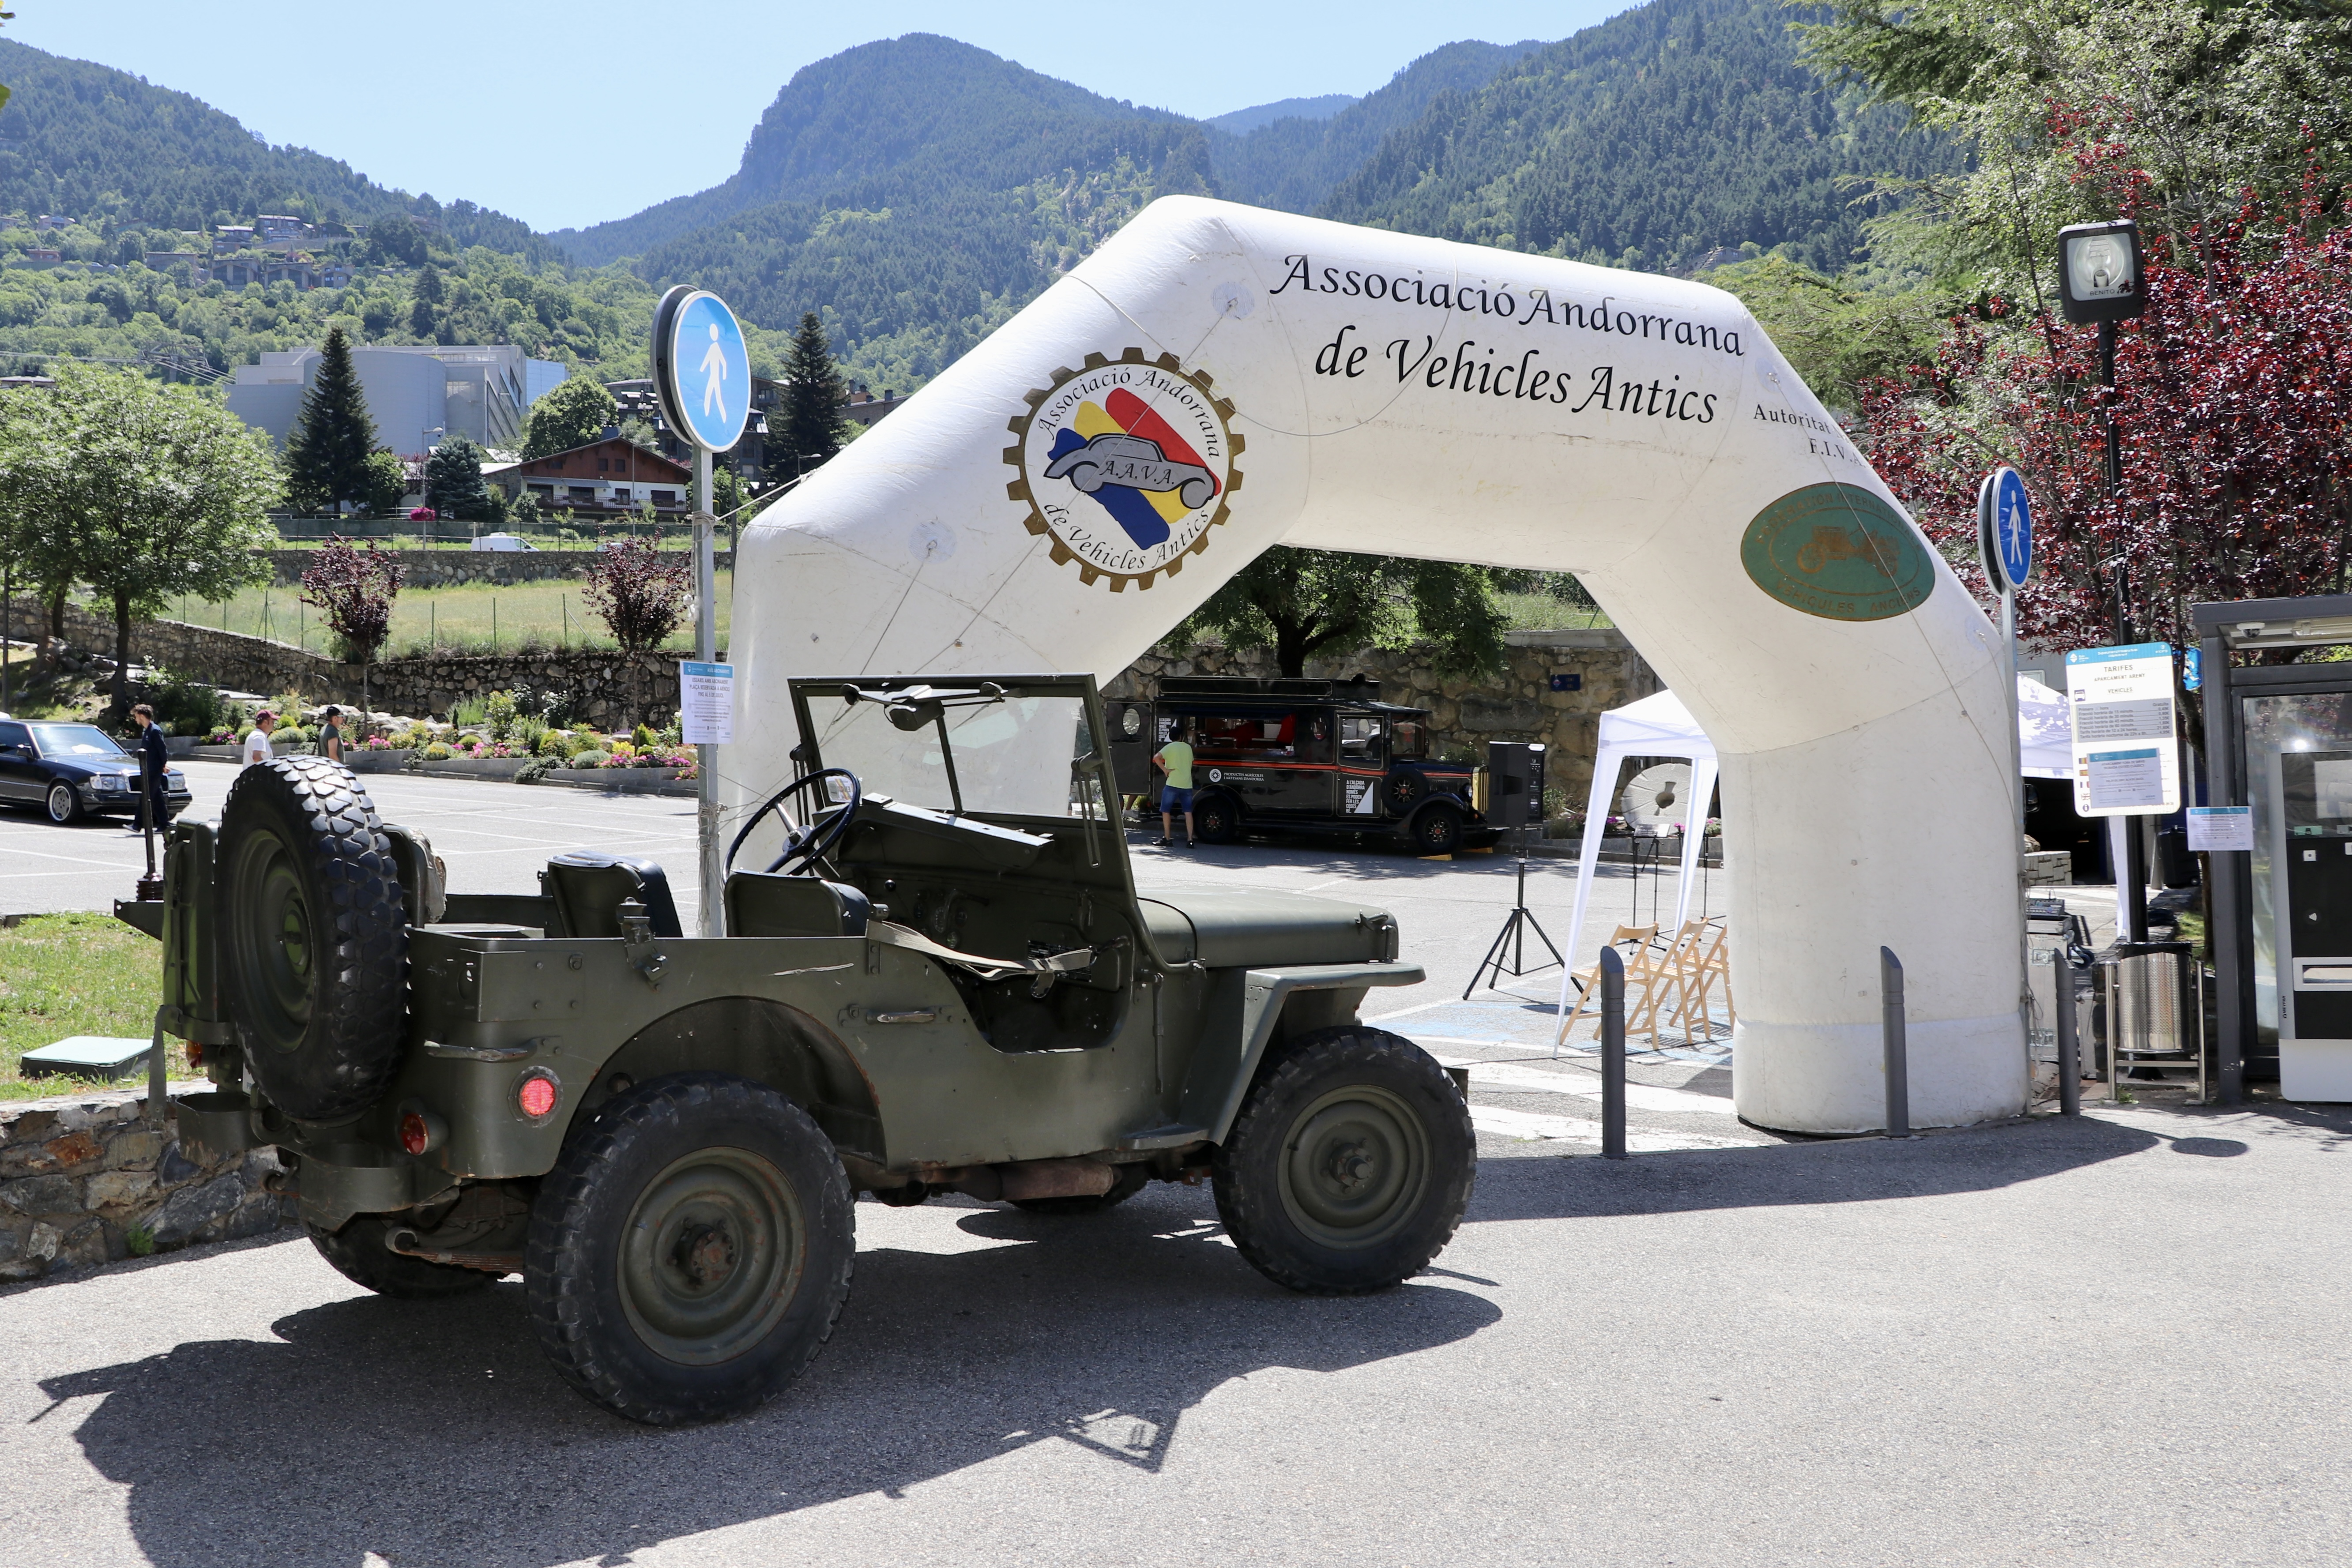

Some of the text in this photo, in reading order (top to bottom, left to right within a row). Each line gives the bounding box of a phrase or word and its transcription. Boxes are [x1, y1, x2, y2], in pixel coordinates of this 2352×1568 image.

[1269, 255, 1744, 356] Associació Andorrana
[1315, 325, 1717, 423] de Vehicles Antics
[1039, 367, 1219, 459] Associació Andorrana
[1754, 404, 1831, 434] Autoritat
[1099, 460, 1174, 485] A.A.V.A.
[1044, 504, 1208, 569] de Vehicles Antics
[1776, 579, 1921, 614] VEHICULES ANCIENS
